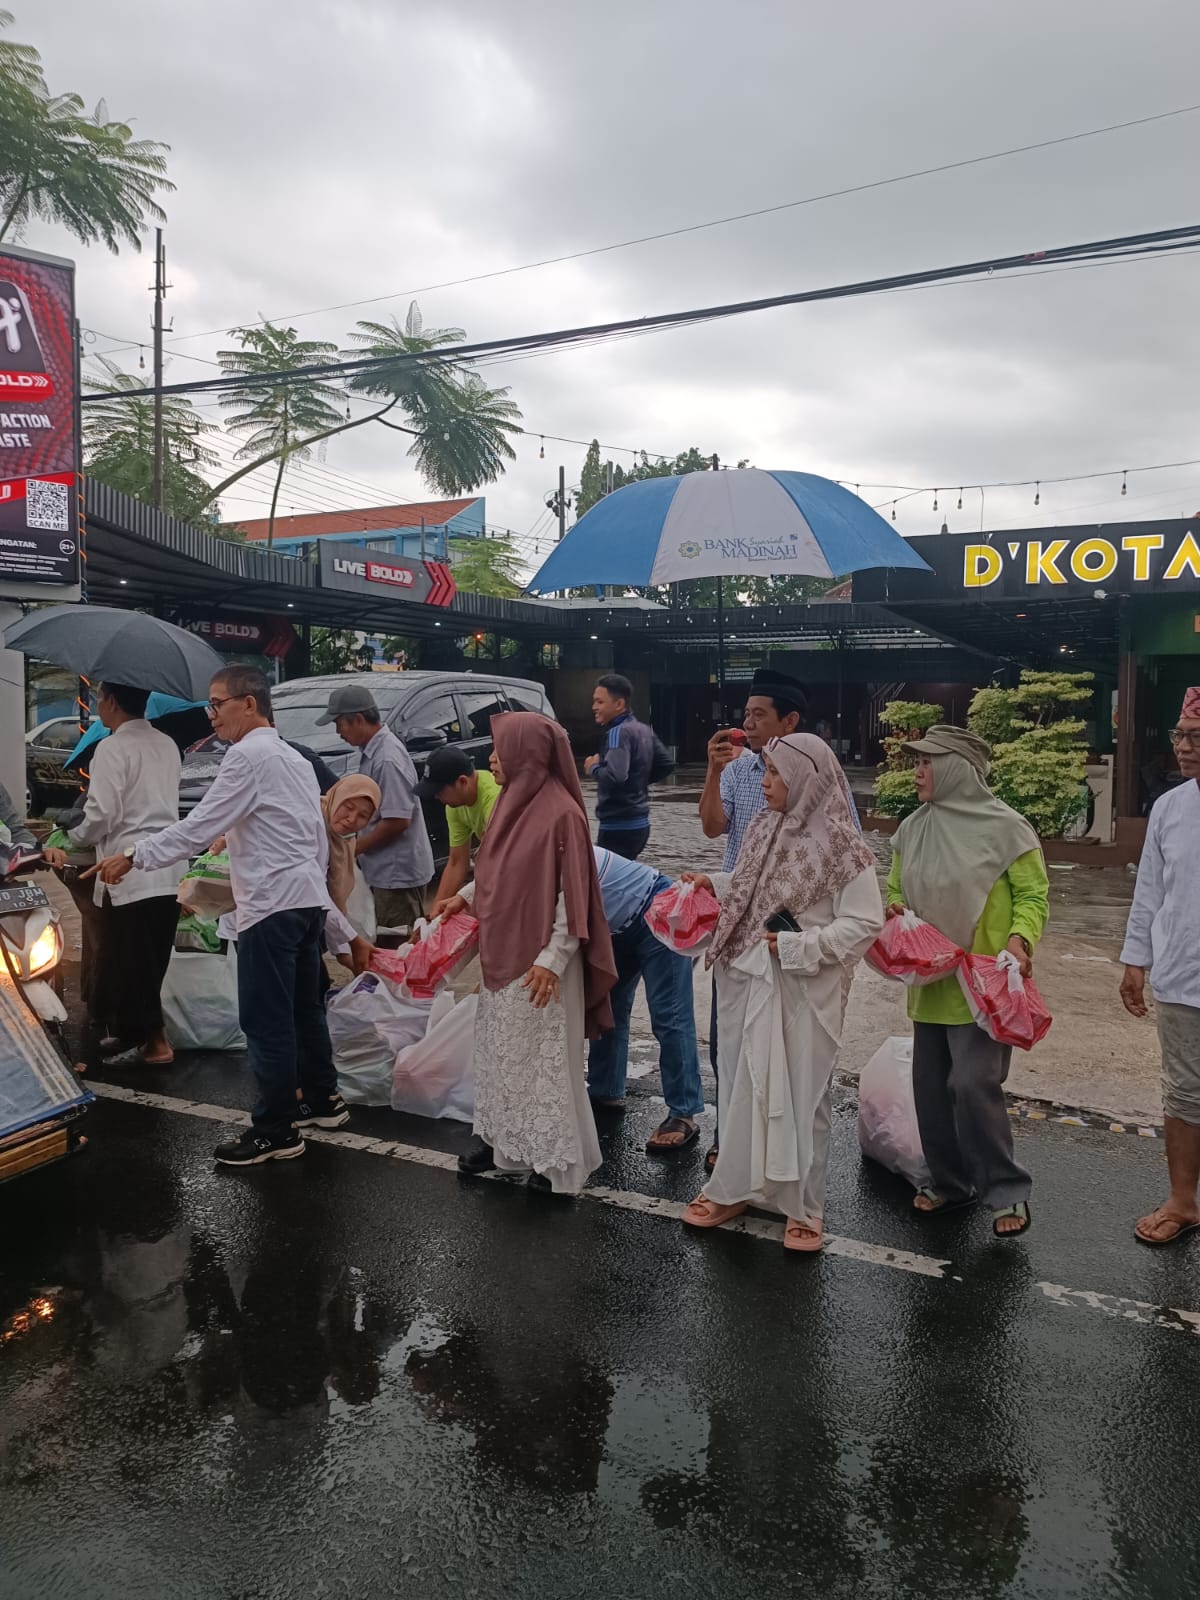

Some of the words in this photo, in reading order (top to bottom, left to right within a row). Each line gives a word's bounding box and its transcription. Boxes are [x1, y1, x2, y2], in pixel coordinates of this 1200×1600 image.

[28, 520, 51, 528] SCAN
[704, 538, 747, 549] BANK
[722, 545, 797, 558] MADINAH
[333, 558, 367, 577] LIVE
[370, 564, 404, 582] BOLD
[215, 622, 251, 637] BOLD
